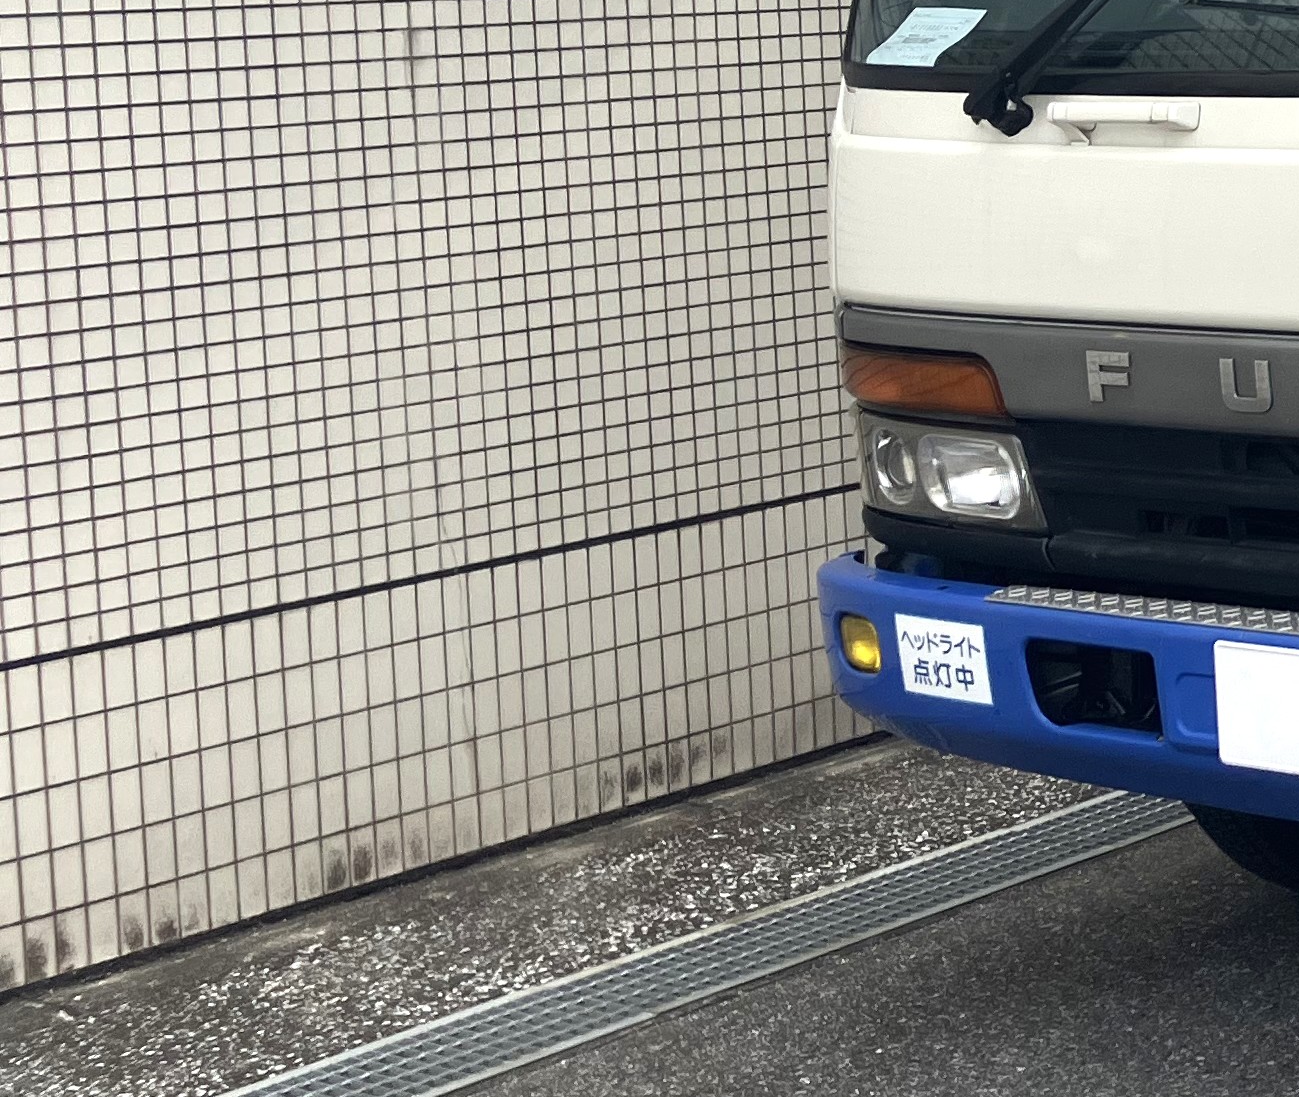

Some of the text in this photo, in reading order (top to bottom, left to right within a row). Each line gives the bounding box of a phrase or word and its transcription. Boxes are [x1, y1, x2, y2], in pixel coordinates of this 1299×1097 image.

[901, 630, 981, 659] ヘッドライト
[913, 657, 975, 692] 点灯中
